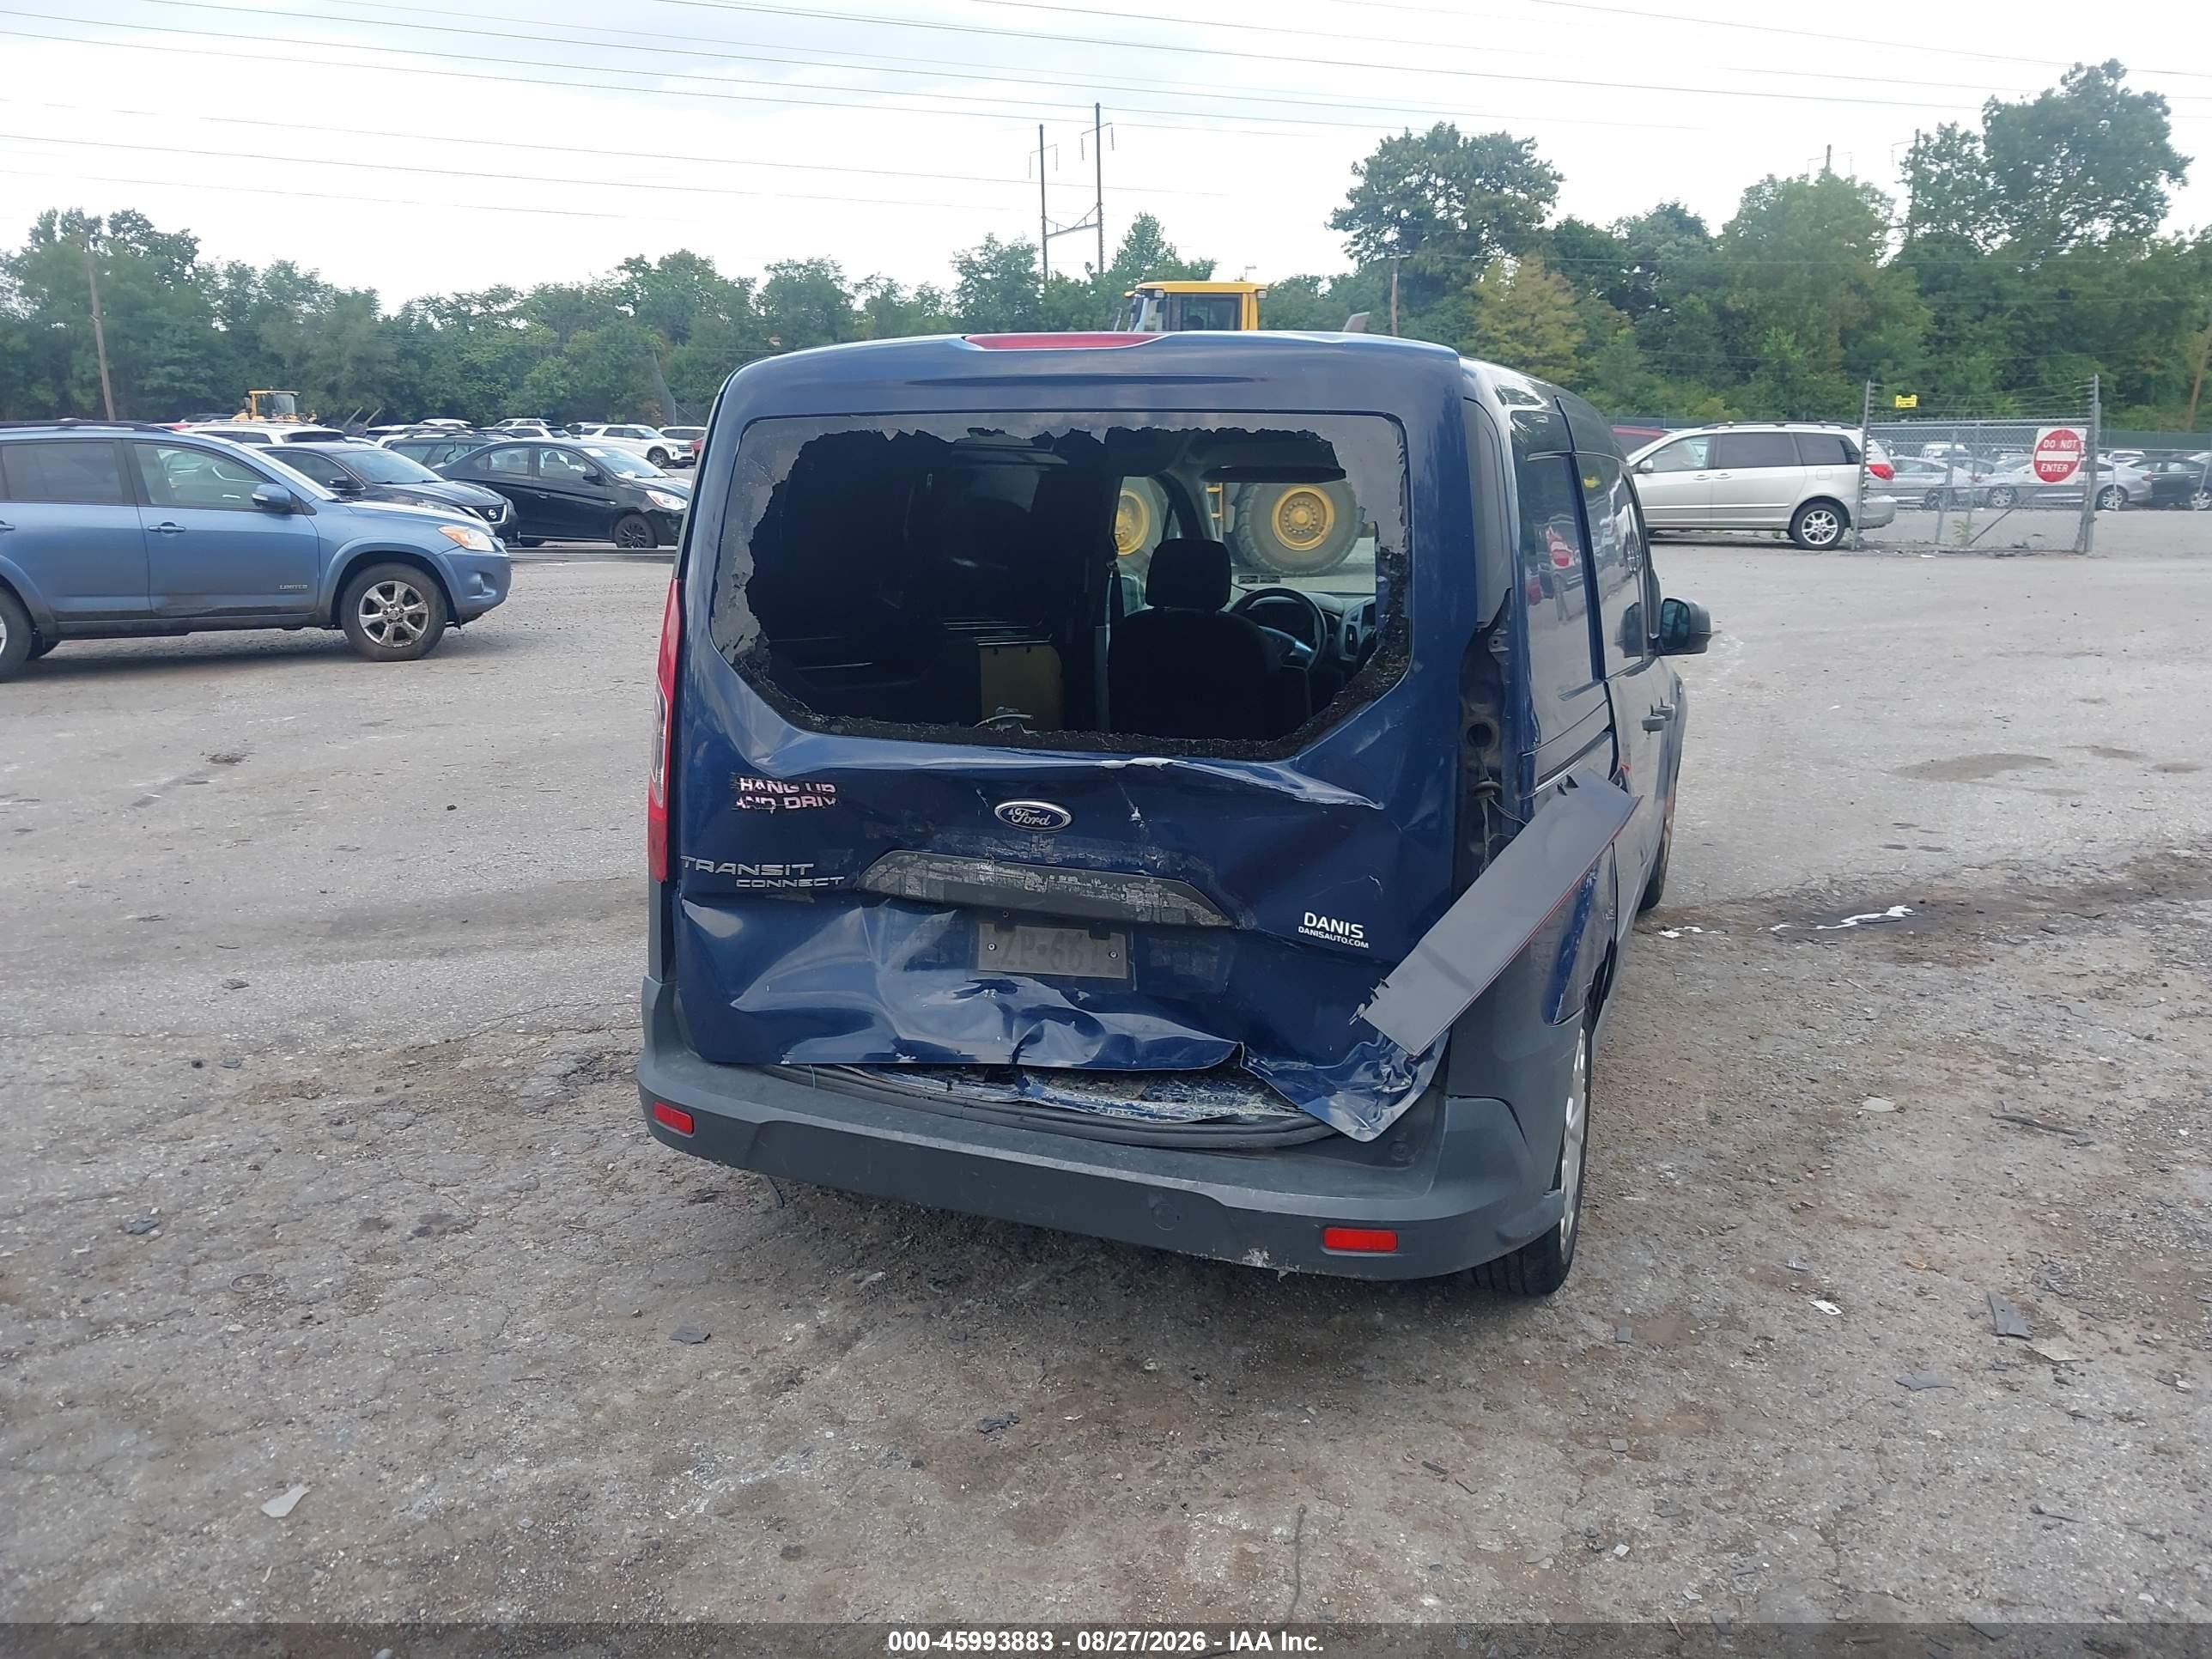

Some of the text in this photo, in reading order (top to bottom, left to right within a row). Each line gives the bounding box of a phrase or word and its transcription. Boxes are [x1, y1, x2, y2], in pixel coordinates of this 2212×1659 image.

[2044, 439, 2078, 448] DO NOT
[2041, 464, 2069, 473] ENTER
[783, 795, 837, 809] DRIV
[1008, 807, 1051, 826] Ford
[680, 855, 814, 876] TRANSIT
[736, 876, 845, 888] CONNECT
[1304, 911, 1364, 939] DANIS
[1297, 926, 1369, 949] DANISAUTO.COM
